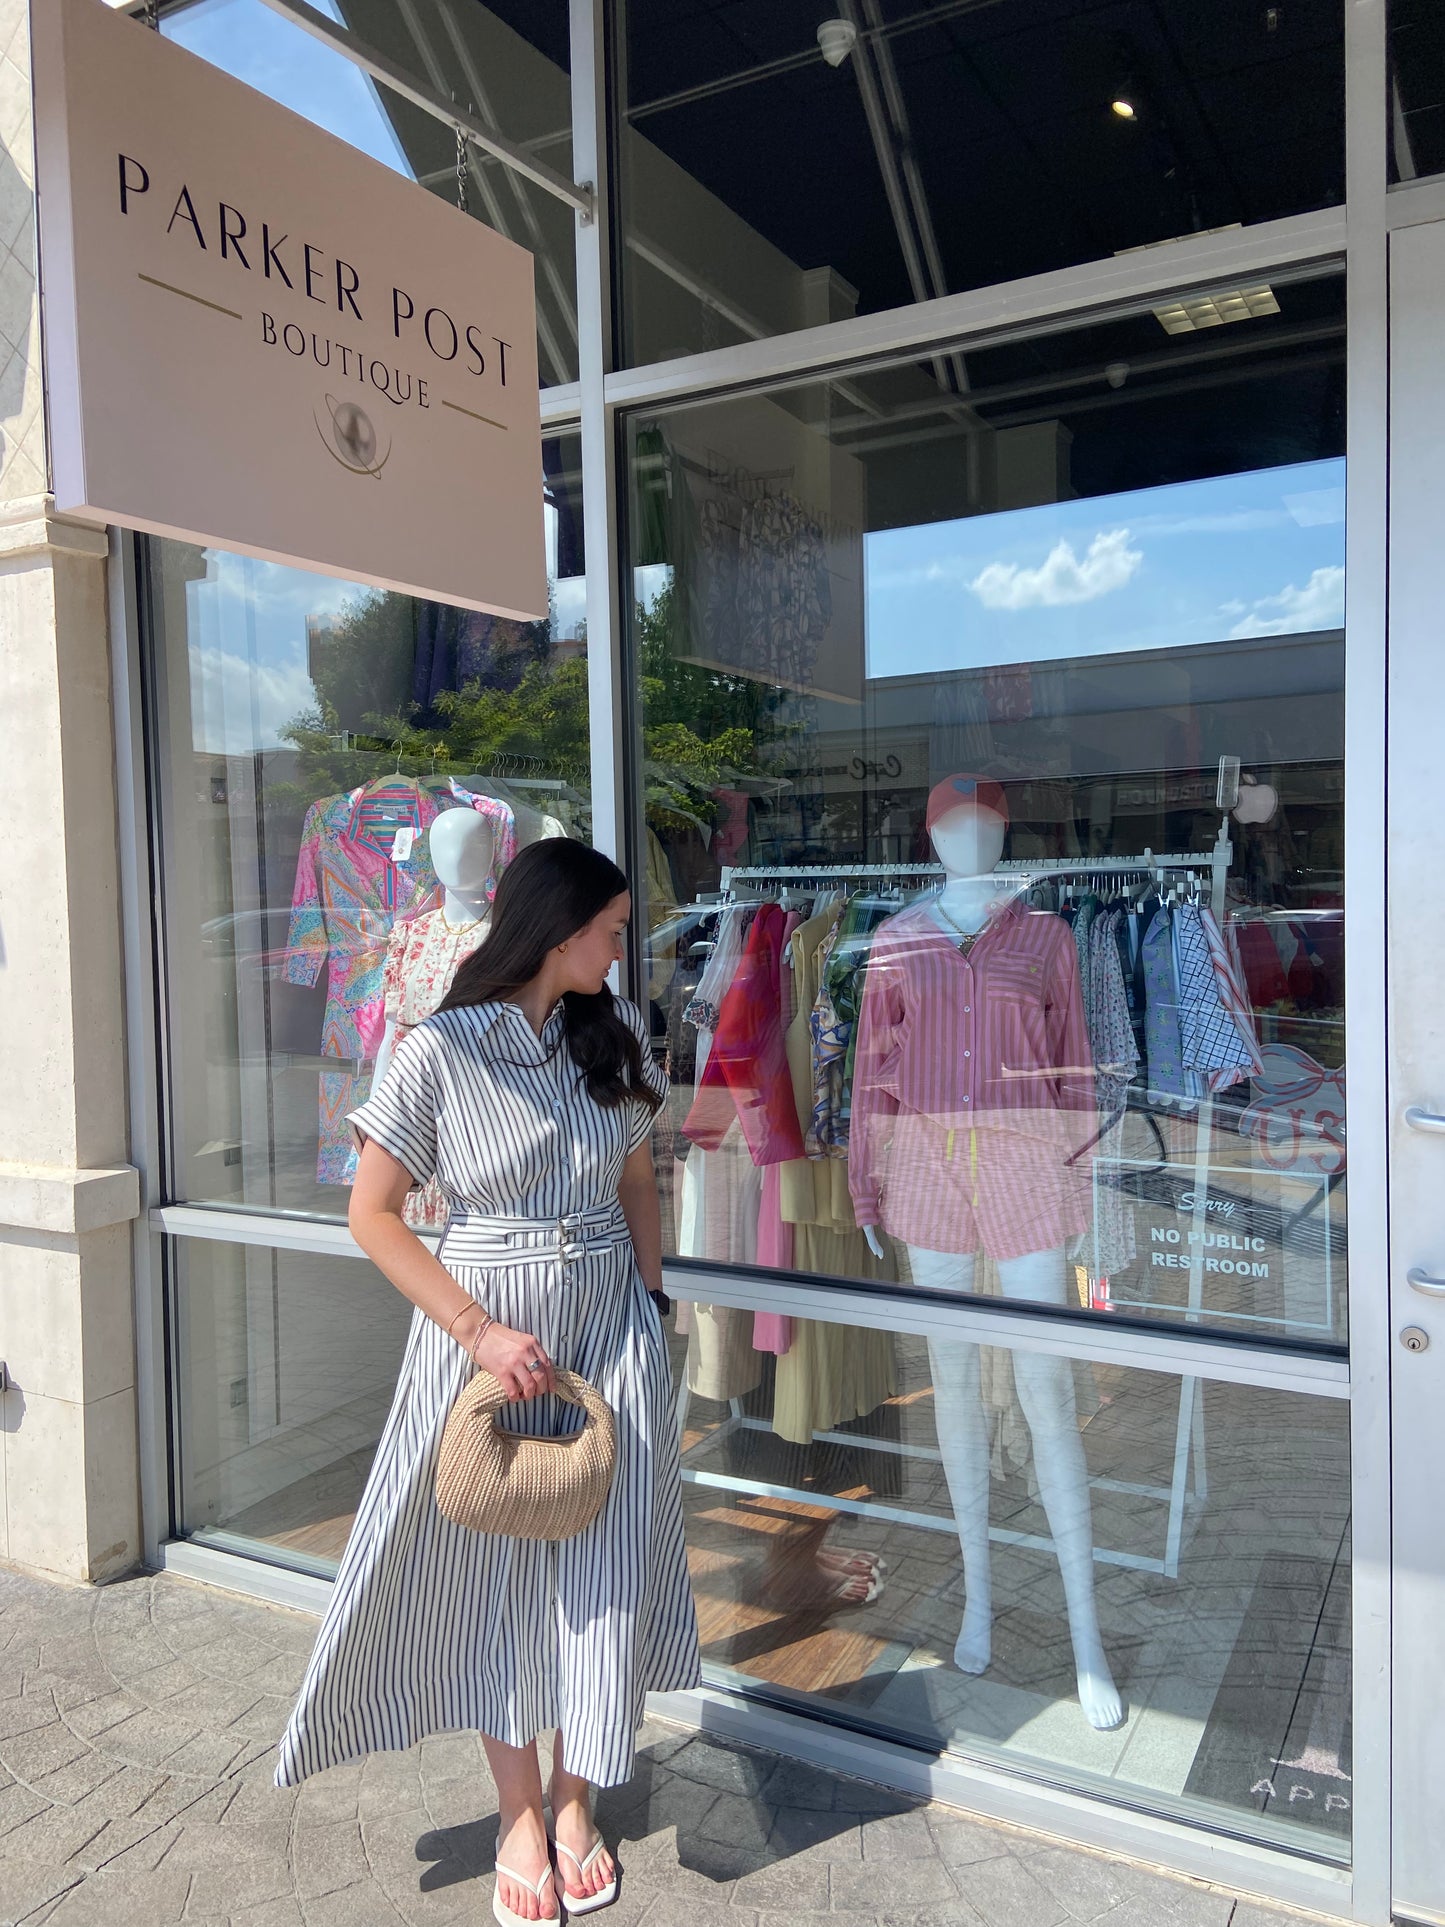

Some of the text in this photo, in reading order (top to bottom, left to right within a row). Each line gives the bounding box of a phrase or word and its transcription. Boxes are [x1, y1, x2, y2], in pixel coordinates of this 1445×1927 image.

[117, 153, 513, 388] PARKER POST
[260, 311, 431, 409] BOUTIQUE
[1177, 1191, 1237, 1219] Sorry
[1150, 1226, 1266, 1253] NO PUBLIC
[1151, 1251, 1270, 1279] RESTROOM
